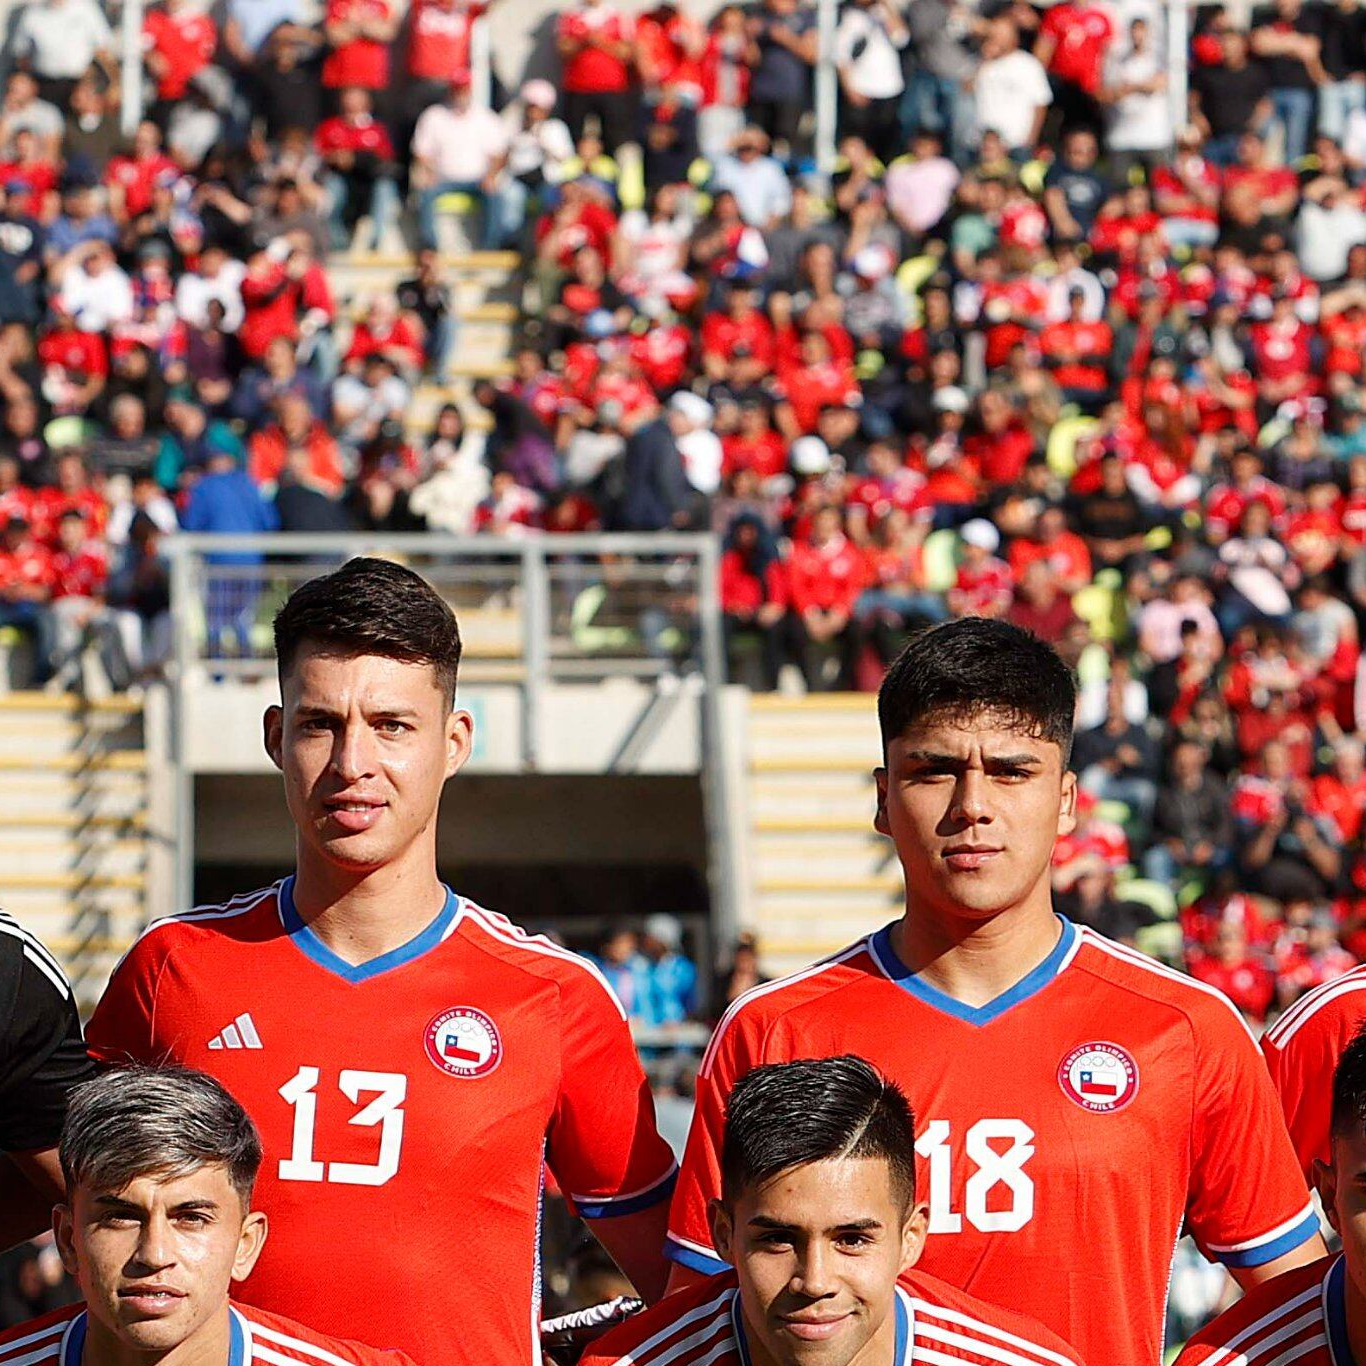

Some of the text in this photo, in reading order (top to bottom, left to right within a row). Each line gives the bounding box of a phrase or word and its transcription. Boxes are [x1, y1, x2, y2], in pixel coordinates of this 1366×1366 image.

[432, 1011, 497, 1046] COMITE OLIMPICO
[444, 1063, 477, 1075] CHILE
[1065, 1045, 1133, 1075] COMITE OLIMPICO
[1082, 1101, 1115, 1111] CHILE
[278, 1066, 407, 1186] 13
[914, 1118, 1035, 1234] 18
